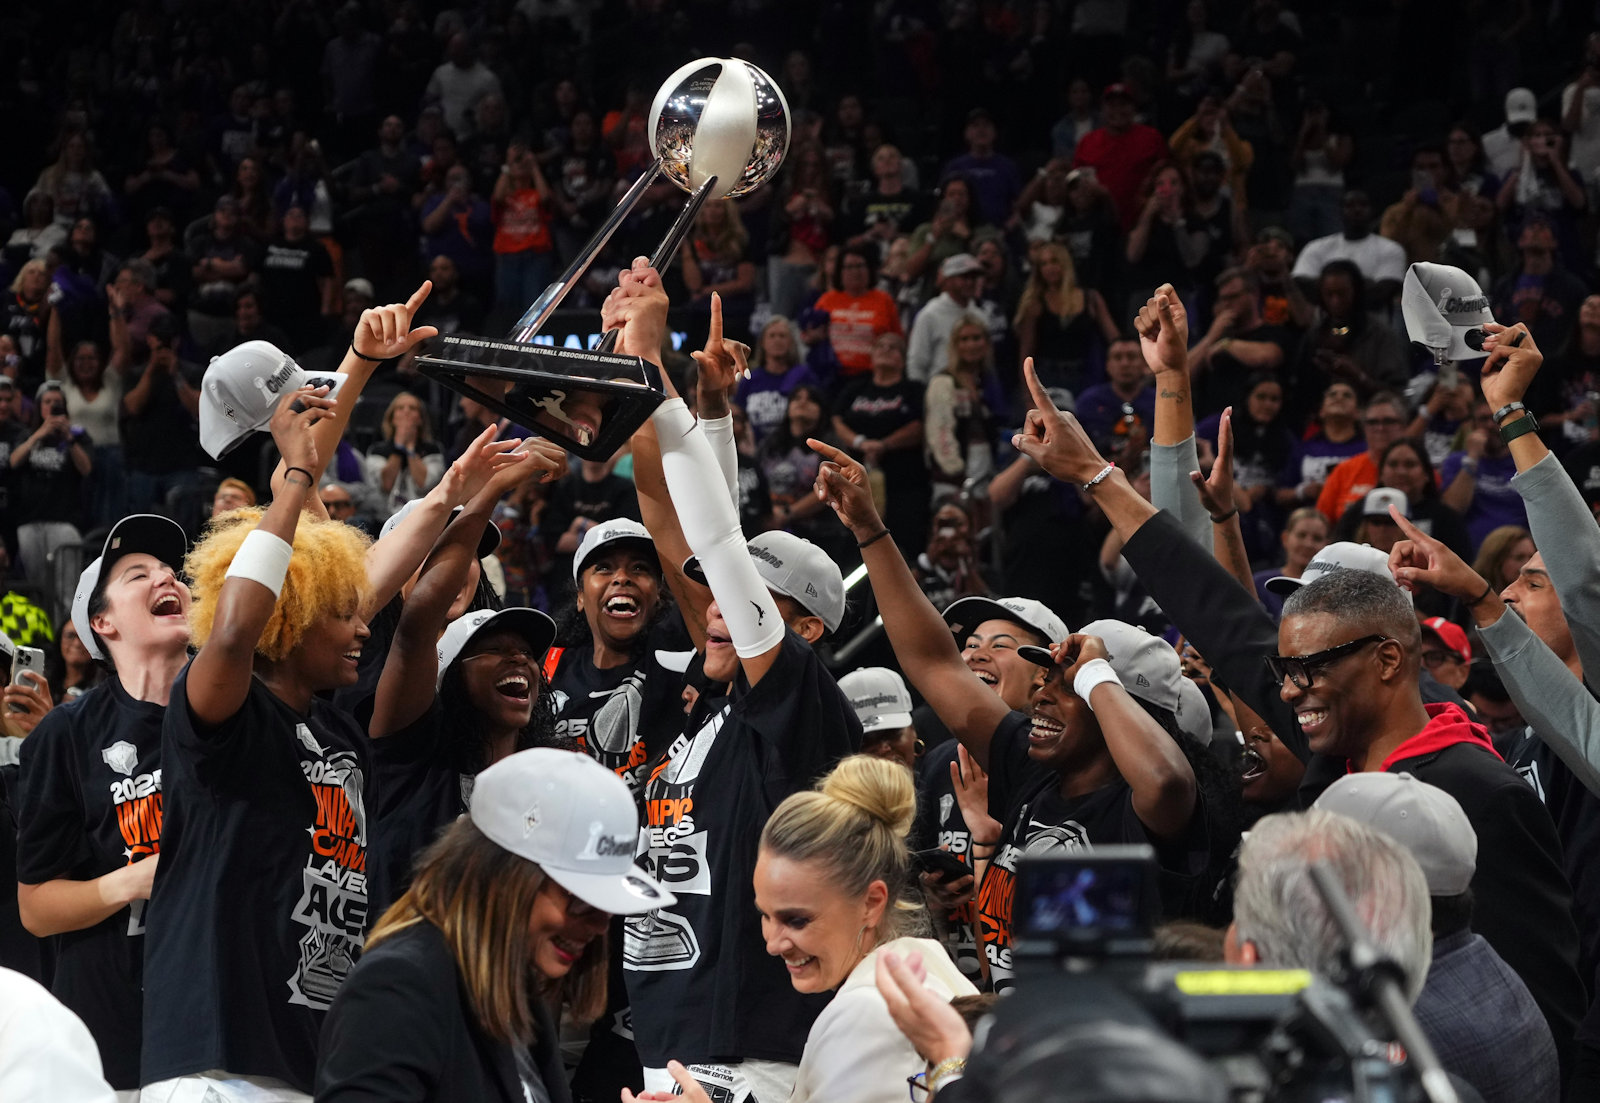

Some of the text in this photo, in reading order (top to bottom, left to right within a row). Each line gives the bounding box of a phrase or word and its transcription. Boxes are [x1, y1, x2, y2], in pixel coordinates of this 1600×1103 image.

[443, 336, 638, 367] 2025 WOMEN'S NATIONAL BASKETBALL ASSOCIATION CHAMPIONS
[847, 692, 898, 709] hampions
[711, 1072, 734, 1082] EDITION
